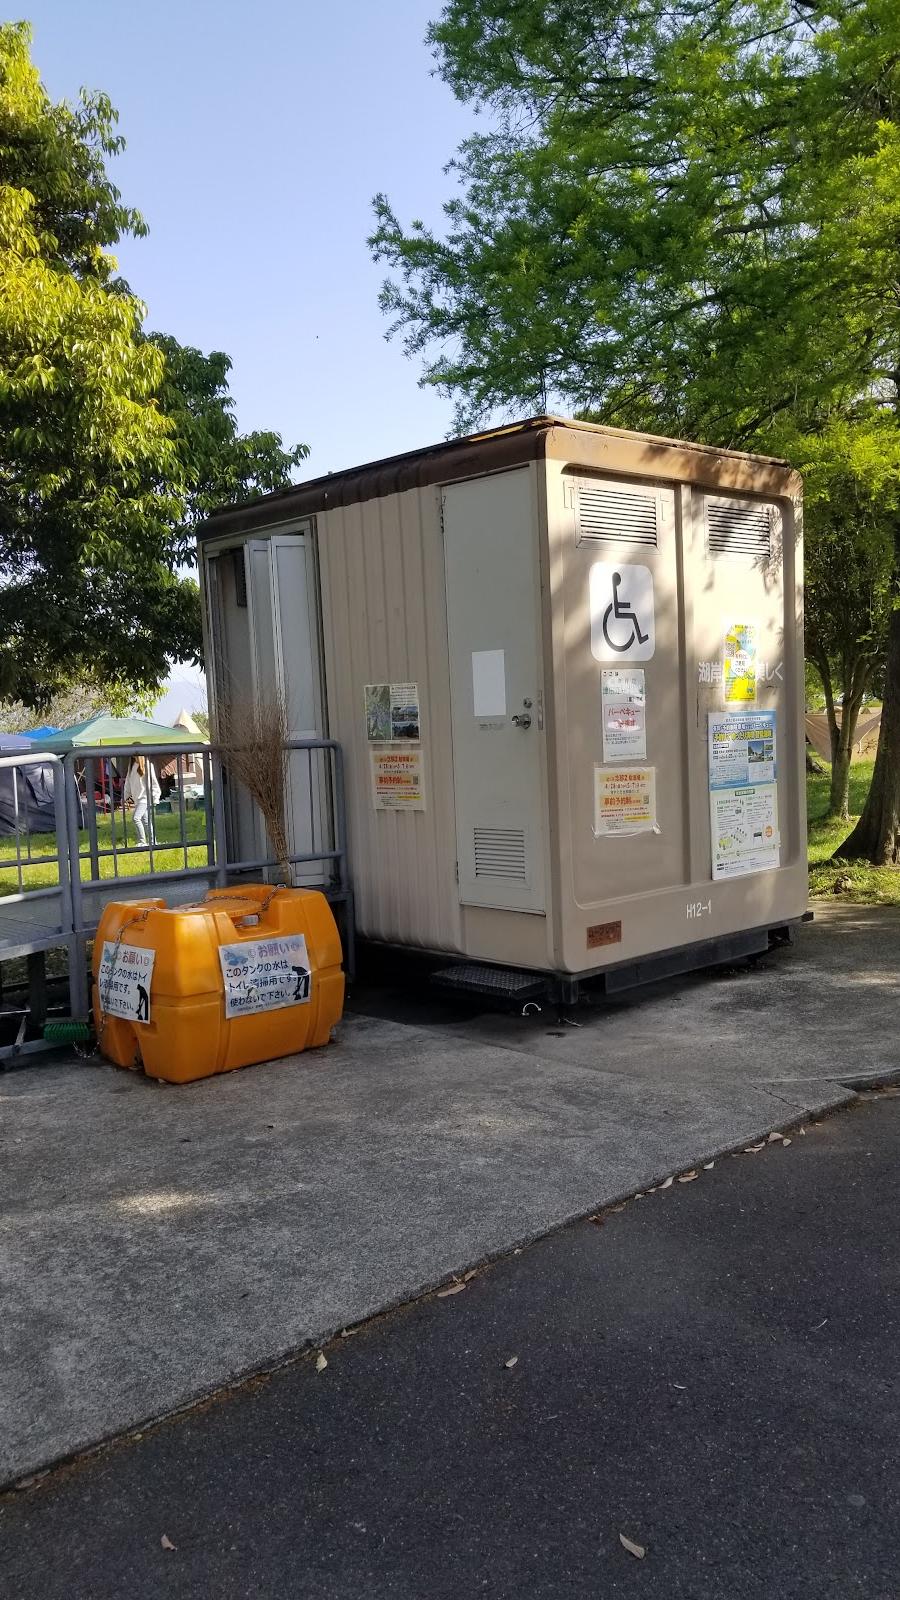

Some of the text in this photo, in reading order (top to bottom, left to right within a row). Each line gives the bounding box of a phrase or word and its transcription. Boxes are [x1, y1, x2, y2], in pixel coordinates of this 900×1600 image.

[608, 707, 640, 716] バーベキュー
[686, 899, 712, 919] H12-1
[122, 950, 143, 965] お願い
[257, 942, 290, 959] お願い
[226, 959, 289, 978] このタンクの水は
[230, 989, 291, 1008] 使わないで下さい。
